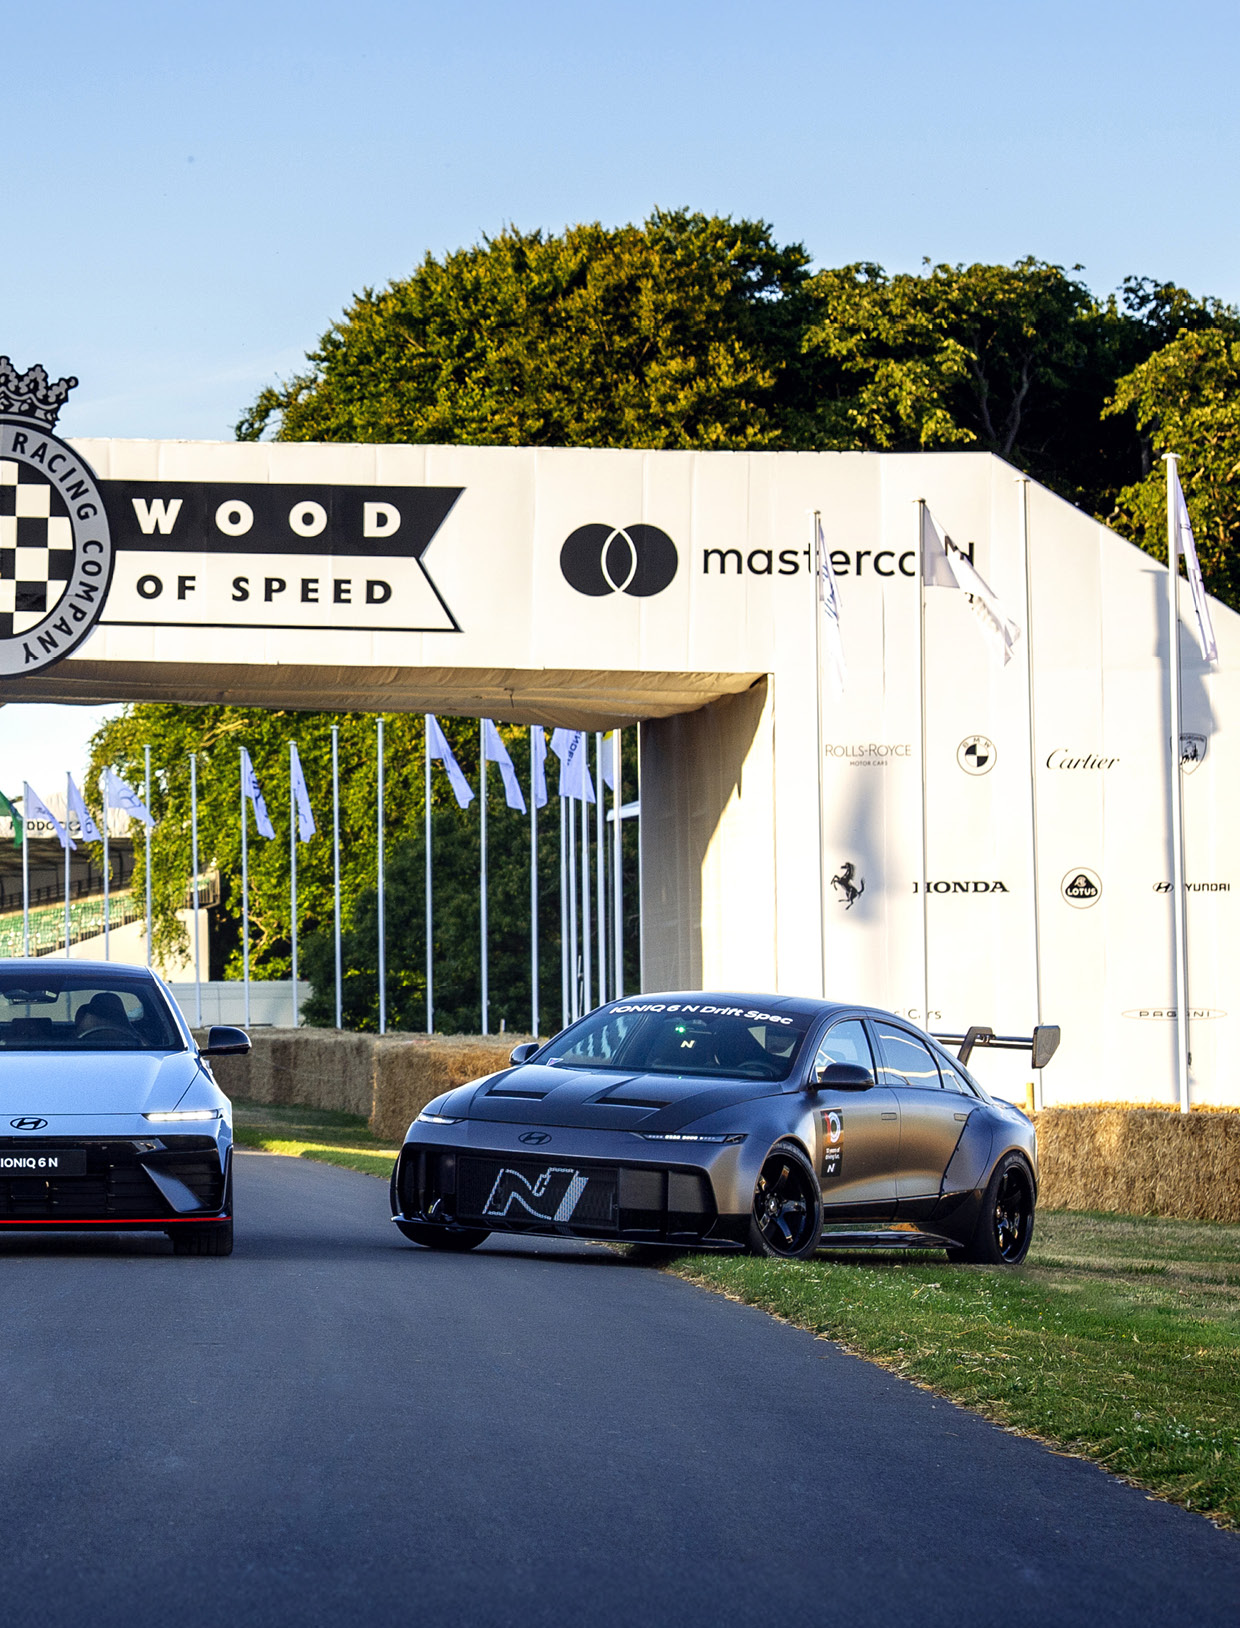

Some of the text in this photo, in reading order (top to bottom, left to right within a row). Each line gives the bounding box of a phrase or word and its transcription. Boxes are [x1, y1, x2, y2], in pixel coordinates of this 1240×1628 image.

[12, 432, 98, 521] RACING
[132, 498, 401, 538] WOOD
[135, 574, 197, 601] OF
[231, 576, 393, 605] SPEED
[22, 540, 104, 664] COMPANY
[825, 744, 912, 758] ROLLS-ROYCE
[1046, 748, 1120, 770] Cartier
[1067, 887, 1097, 896] LOTUS
[610, 1004, 793, 1025] IONIQ 6 N Drift Spec
[0, 1158, 58, 1169] IONIQ 6 N
